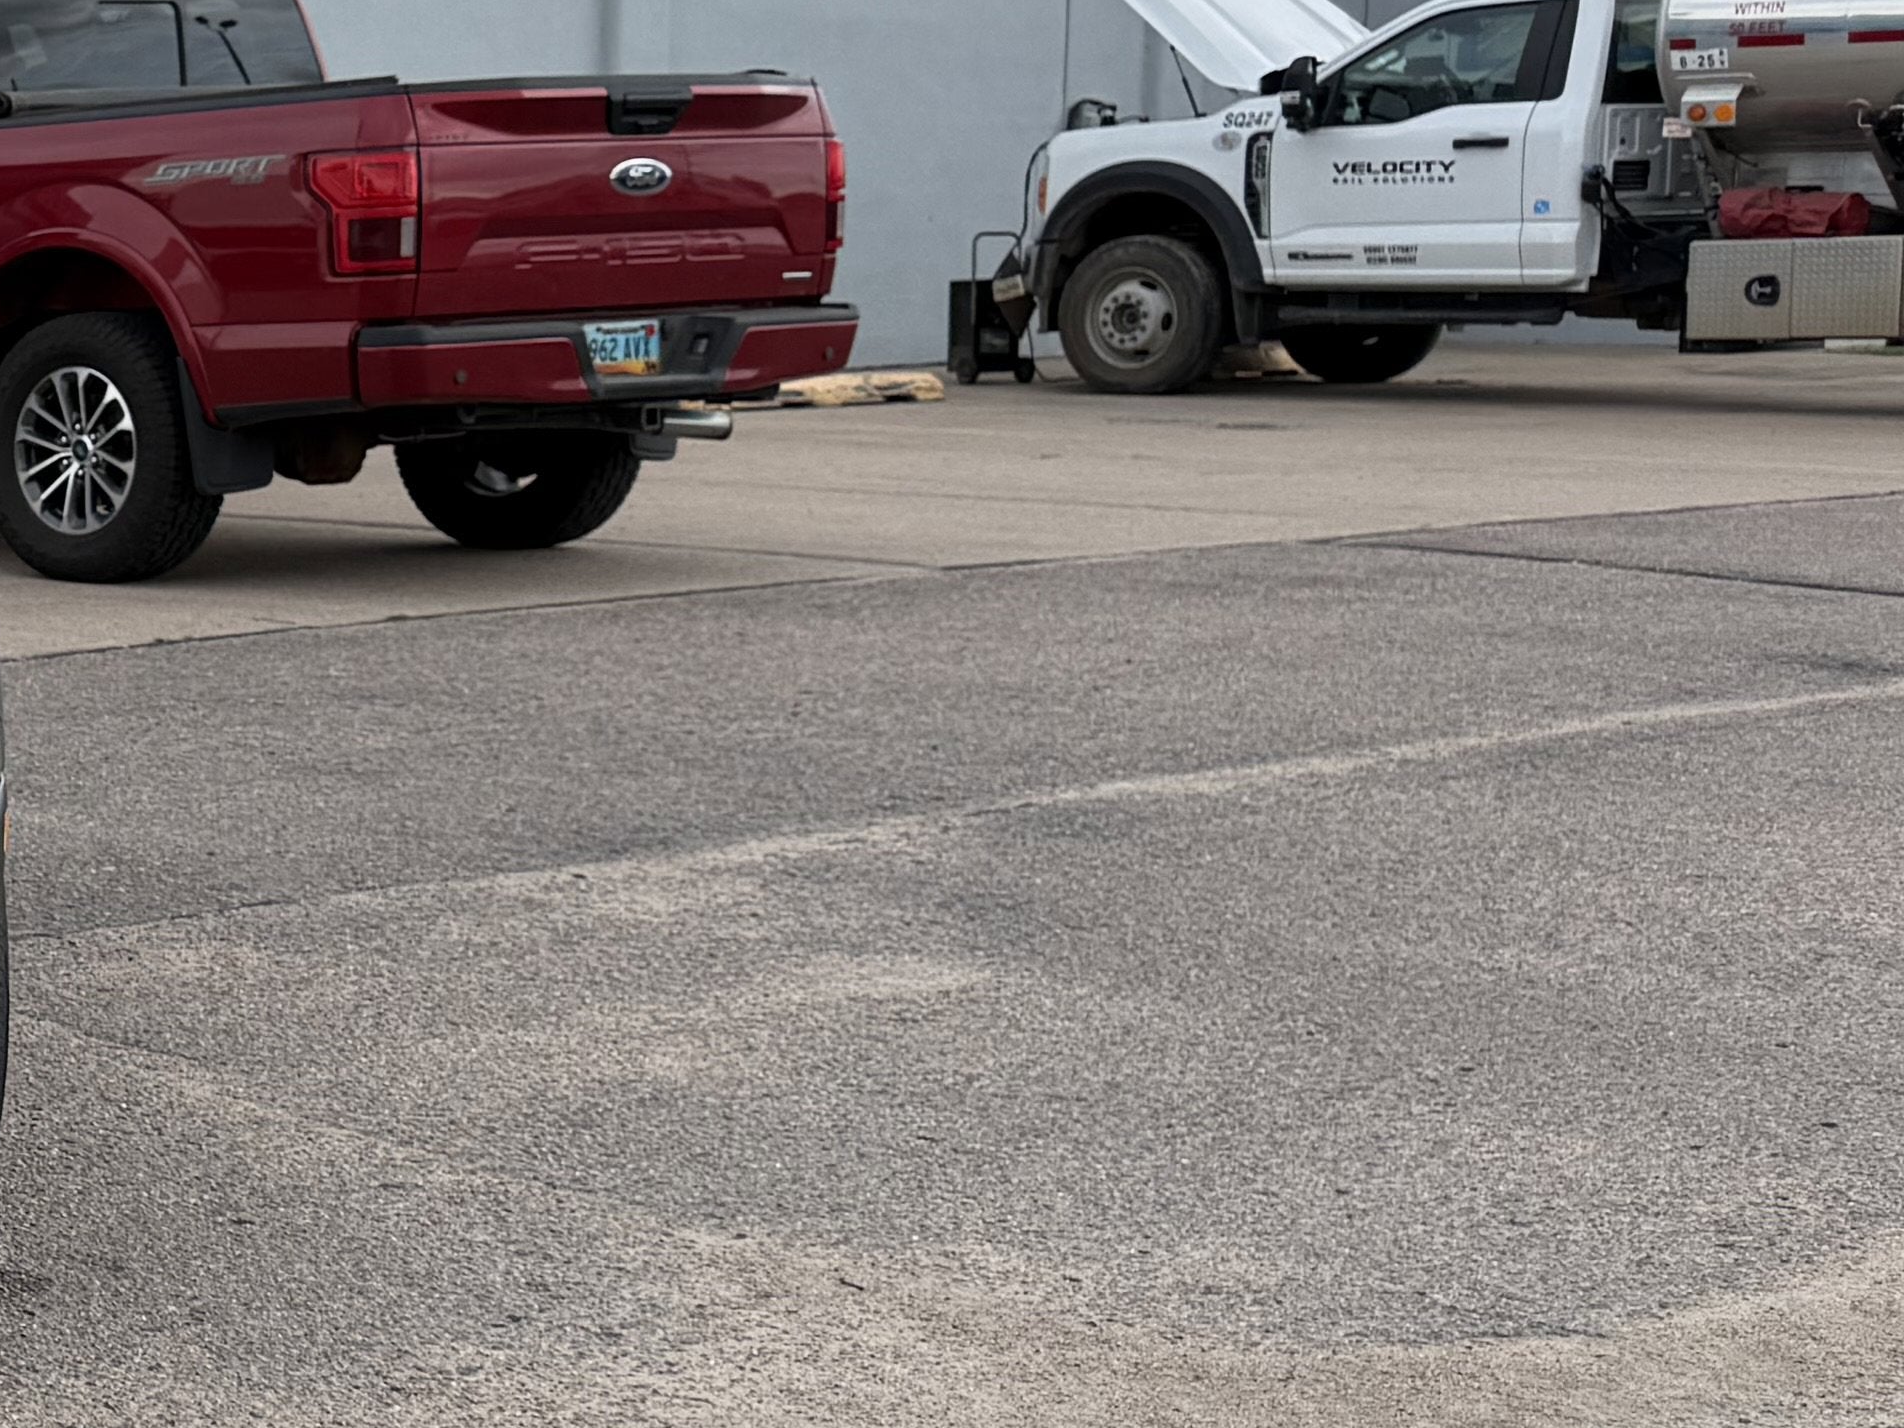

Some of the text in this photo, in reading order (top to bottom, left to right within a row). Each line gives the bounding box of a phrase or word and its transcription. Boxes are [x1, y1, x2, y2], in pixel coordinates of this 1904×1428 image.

[1734, 1, 1786, 15] WITHIN
[1728, 21, 1787, 36] 50 FEET
[1223, 111, 1273, 128] SQ247
[144, 154, 287, 184] SPORT
[1333, 160, 1455, 175] VELOCITY
[1373, 176, 1455, 184] SOLUTIONS
